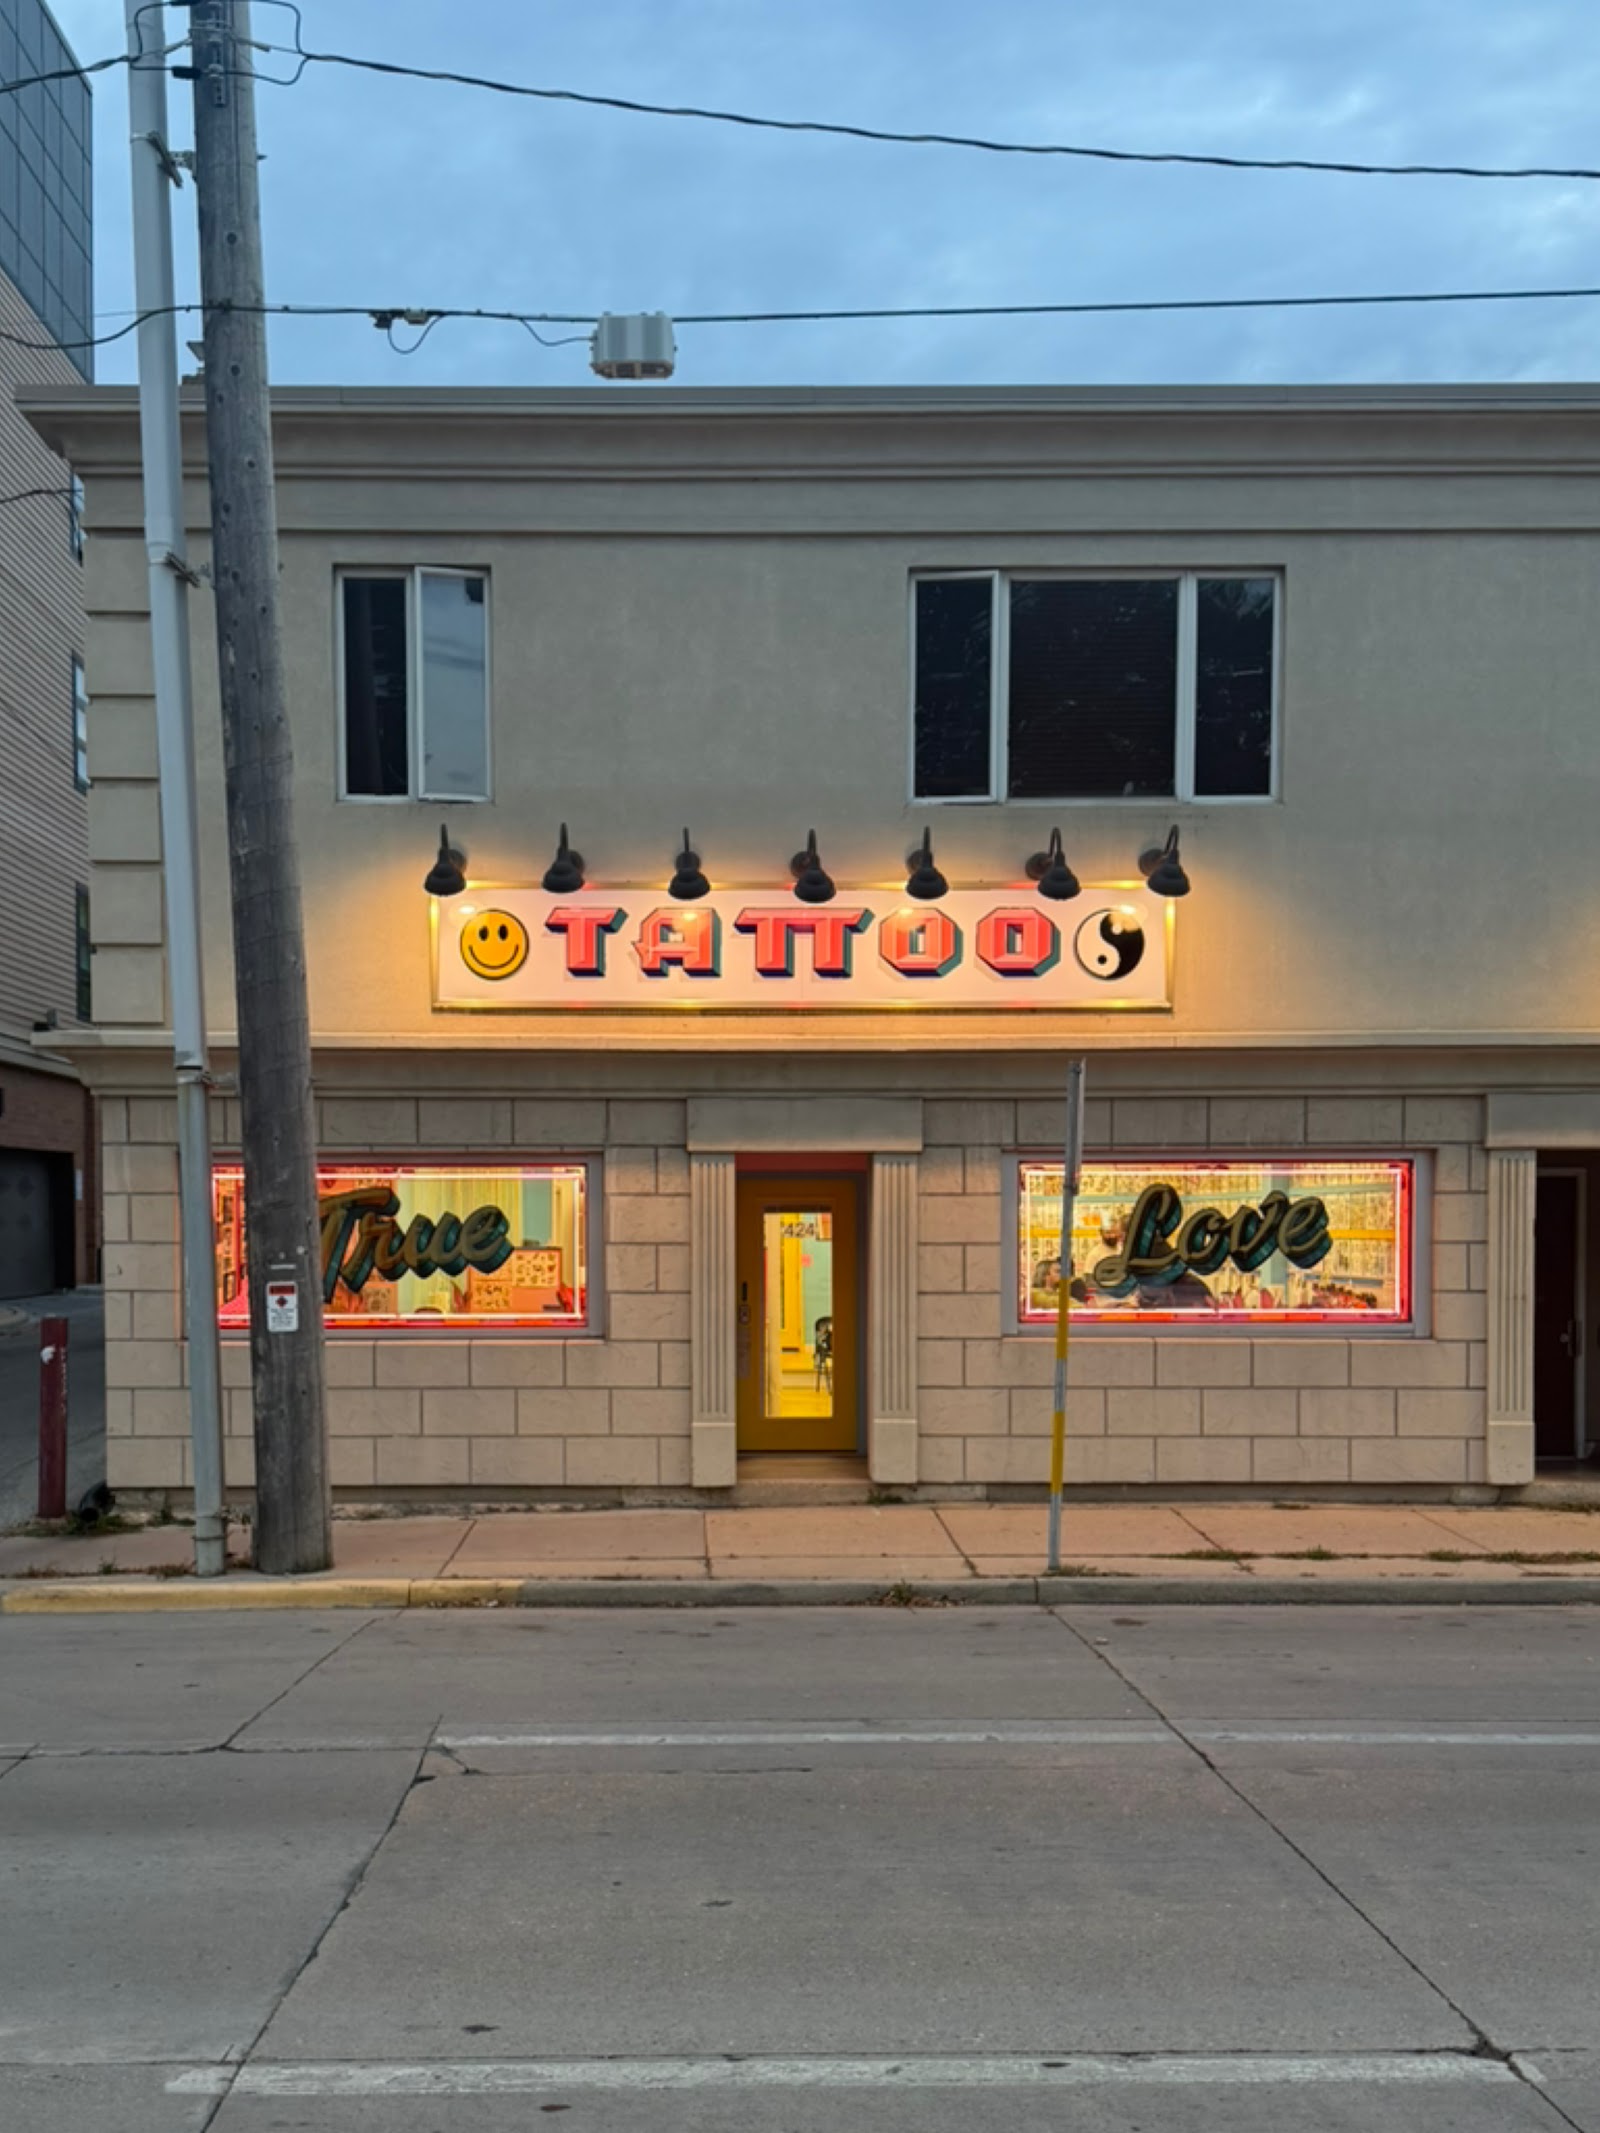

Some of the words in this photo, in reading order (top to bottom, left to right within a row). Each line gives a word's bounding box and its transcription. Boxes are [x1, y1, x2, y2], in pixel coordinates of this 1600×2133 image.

[544, 906, 1061, 979] TATTOO
[318, 1187, 515, 1305] True
[1094, 1183, 1332, 1298] Love
